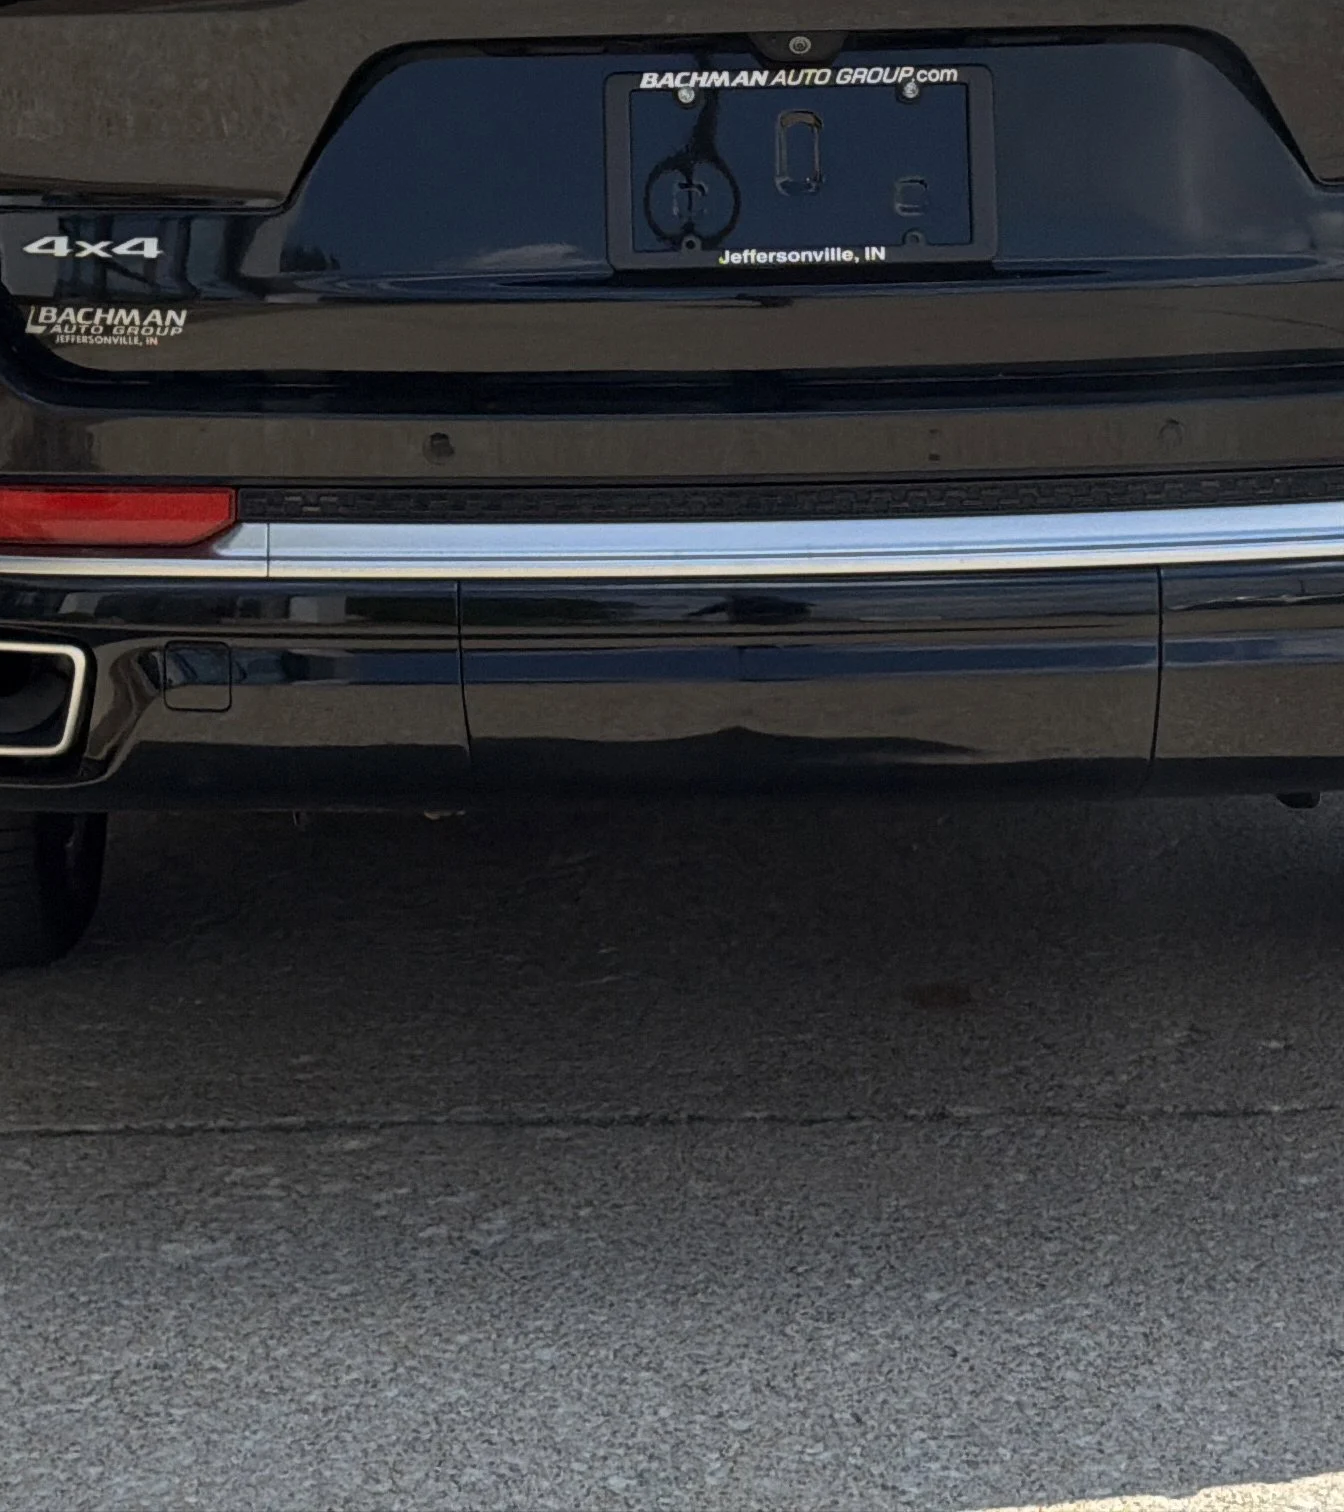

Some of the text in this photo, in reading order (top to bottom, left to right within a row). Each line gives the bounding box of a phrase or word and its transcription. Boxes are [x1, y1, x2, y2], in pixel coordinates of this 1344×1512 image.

[639, 66, 959, 90] BACHMAN AUTO GROUP.com
[22, 235, 165, 258] 4x4
[718, 246, 887, 265] Jeffersonville, IN
[37, 306, 188, 327] BACHMAN
[49, 324, 184, 337] AUTO GROUP
[145, 336, 158, 347] IN
